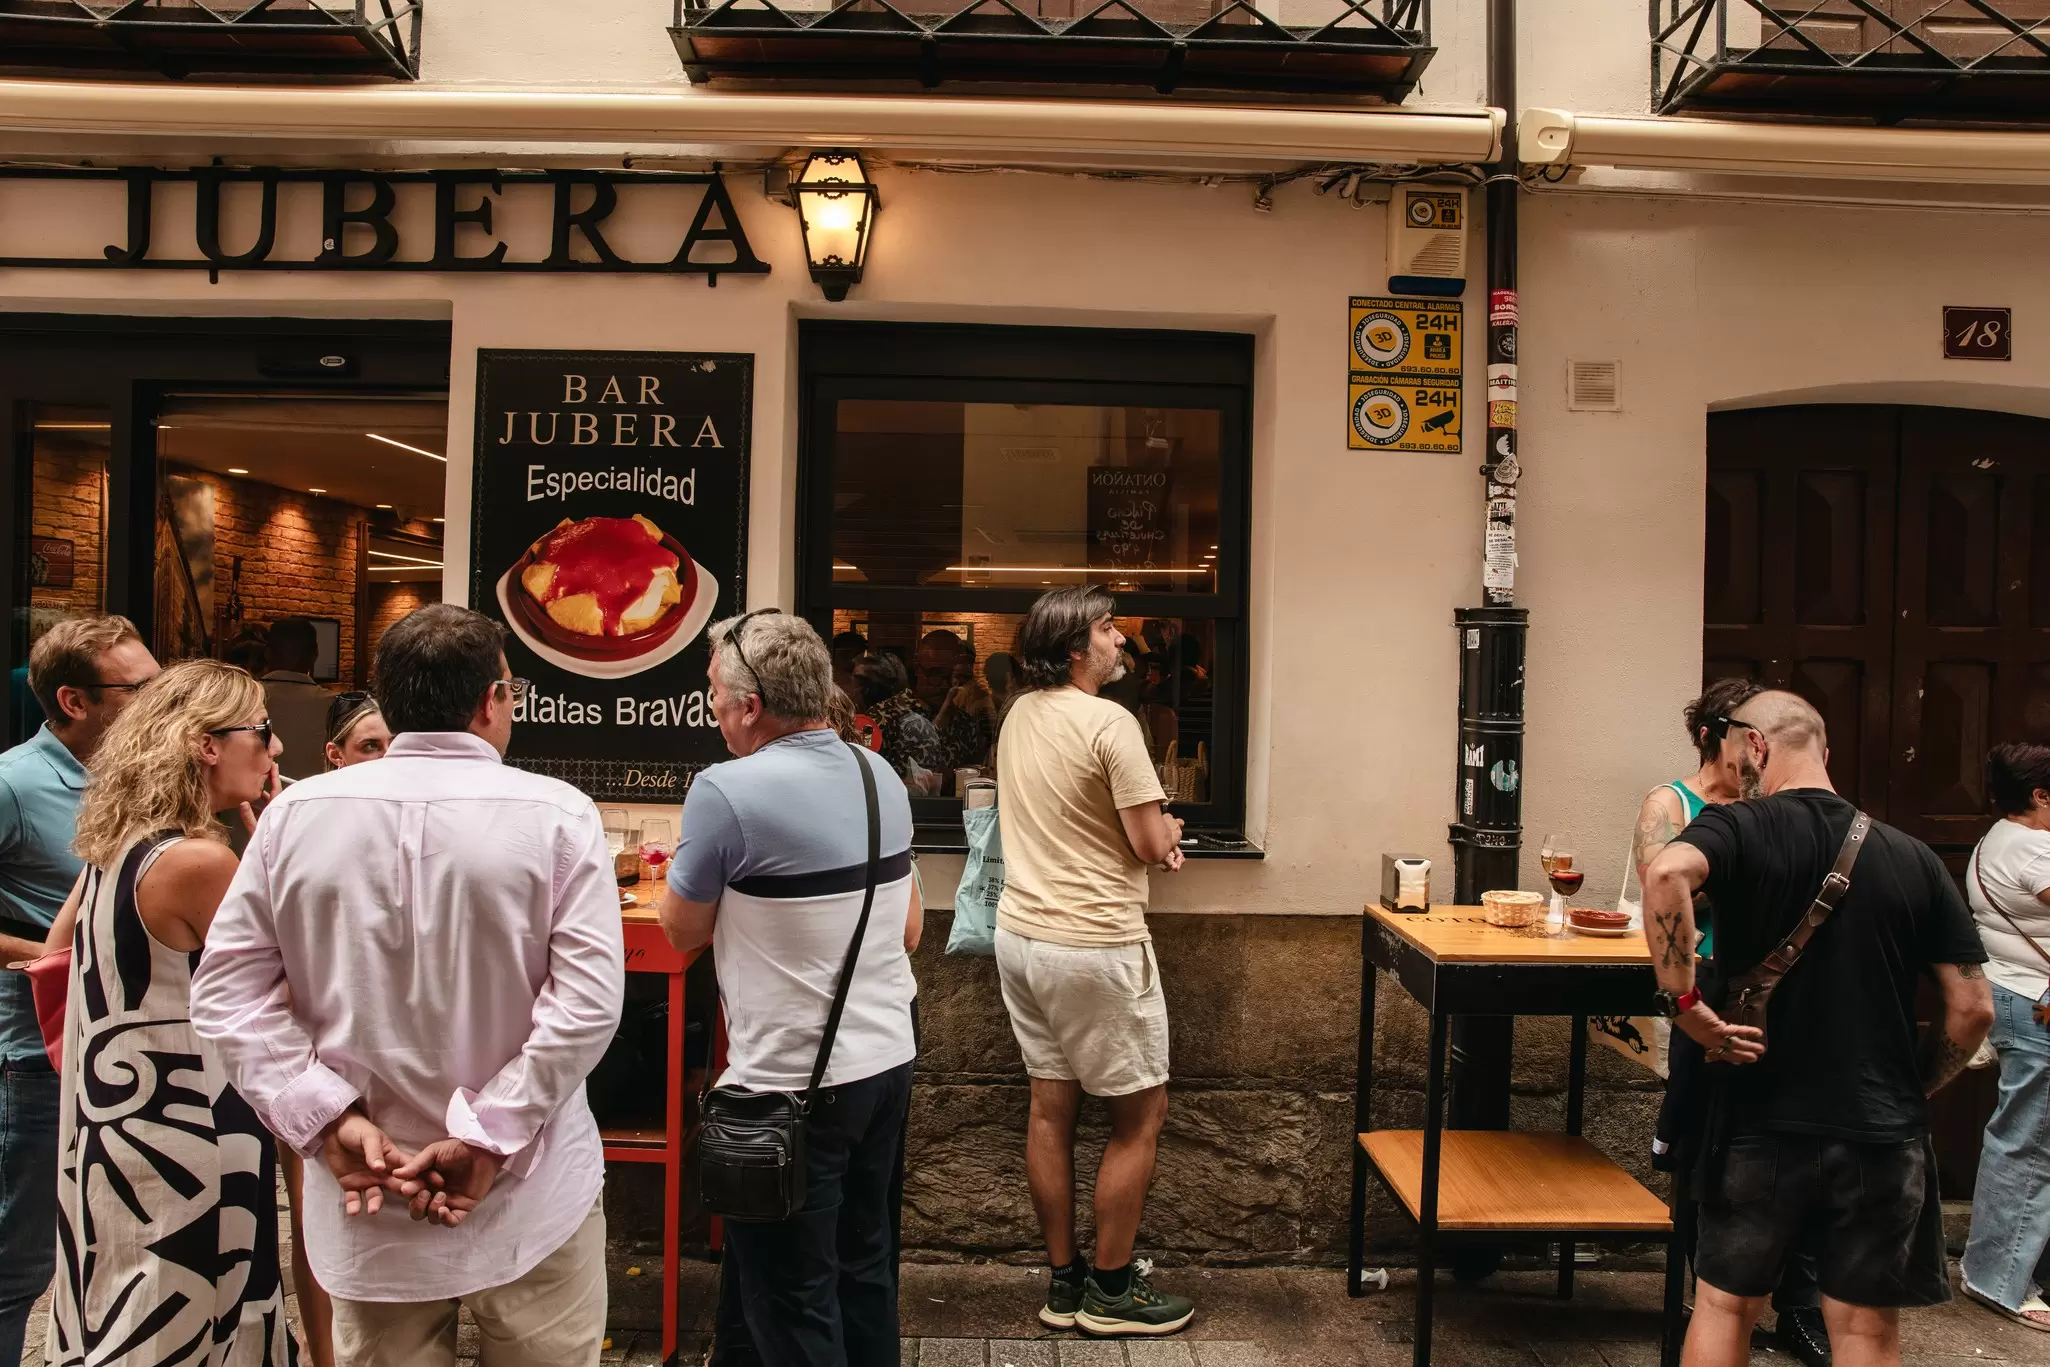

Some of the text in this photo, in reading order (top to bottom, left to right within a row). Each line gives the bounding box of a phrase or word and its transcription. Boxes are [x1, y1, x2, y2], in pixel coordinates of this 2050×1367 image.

[1437, 199, 1460, 208] 24H
[103, 165, 771, 275] JUBERA
[1351, 298, 1461, 311] CONECTADO CENTRAL ALARMAS
[1361, 313, 1402, 327] 3DSEGURIDAD
[1416, 314, 1458, 331] 24H
[1374, 330, 1393, 343] 3D
[1955, 320, 2001, 348] 18
[1400, 365, 1460, 374] 693.60.60.60
[1351, 375, 1460, 387] GRABACIÓN CÁMARAS SEGURIDAD
[561, 374, 665, 405] BAR
[1360, 389, 1401, 403] 3DSEGURIDAD
[1415, 390, 1457, 407] 24H
[1374, 408, 1392, 420] 3D
[498, 411, 725, 449] JUBERA
[1399, 442, 1459, 451] 693.60.60.60
[526, 464, 697, 506] Especialidad
[511, 684, 603, 726] atatas
[982, 856, 1005, 864] Limit
